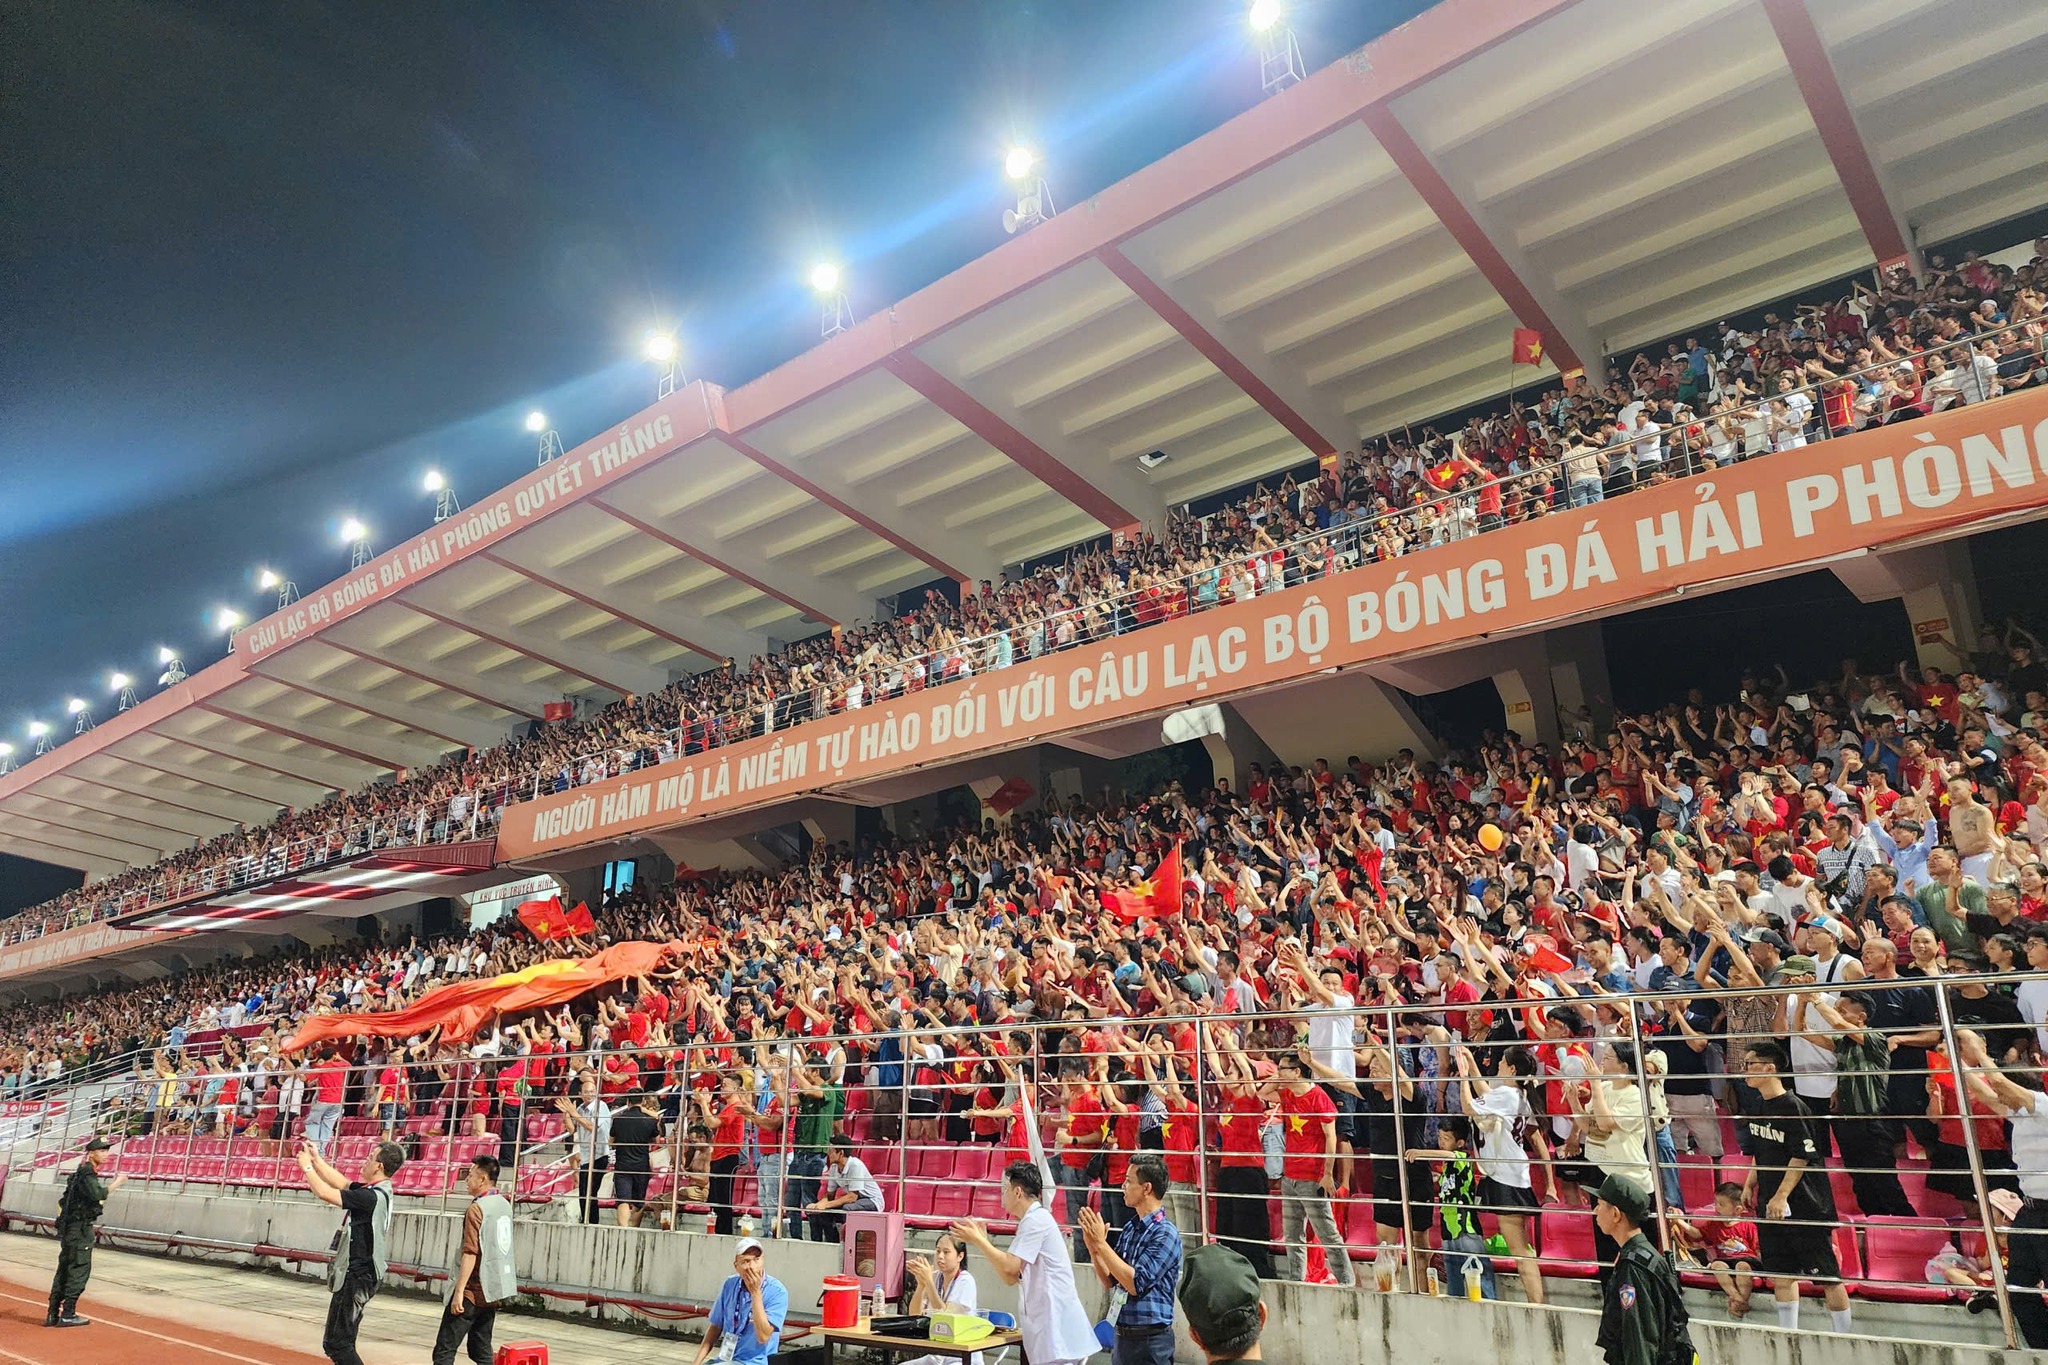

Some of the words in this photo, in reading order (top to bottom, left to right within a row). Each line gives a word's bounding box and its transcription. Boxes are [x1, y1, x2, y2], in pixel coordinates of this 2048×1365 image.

[250, 625, 277, 654] CÂU
[279, 611, 307, 640] LẠC
[309, 594, 331, 624] BỘ
[332, 572, 378, 612] BÓNG
[380, 555, 406, 588] ĐÁ
[407, 536, 440, 574] HẢI
[442, 502, 512, 556] PHÒNG
[515, 458, 583, 517] QUYẾT
[588, 414, 674, 478] THẮNG
[532, 794, 595, 842] NGƯỜI
[600, 782, 652, 826] HÂM
[656, 767, 694, 814] MỘ
[700, 757, 731, 801] LÀ
[737, 737, 808, 792] NIỀM
[816, 725, 855, 776] TỰ
[859, 710, 921, 762] HÀO
[930, 682, 986, 744] ĐỐI
[998, 670, 1056, 728] VỚI
[1069, 651, 1149, 710] CÂU
[1163, 626, 1247, 691] LẠC
[1263, 595, 1330, 665] BỘ
[1346, 558, 1507, 645] BÓNG
[1525, 519, 1618, 601] ĐÁ
[1635, 481, 1763, 574] HẢI
[1803, 1138, 1816, 1153] 2
